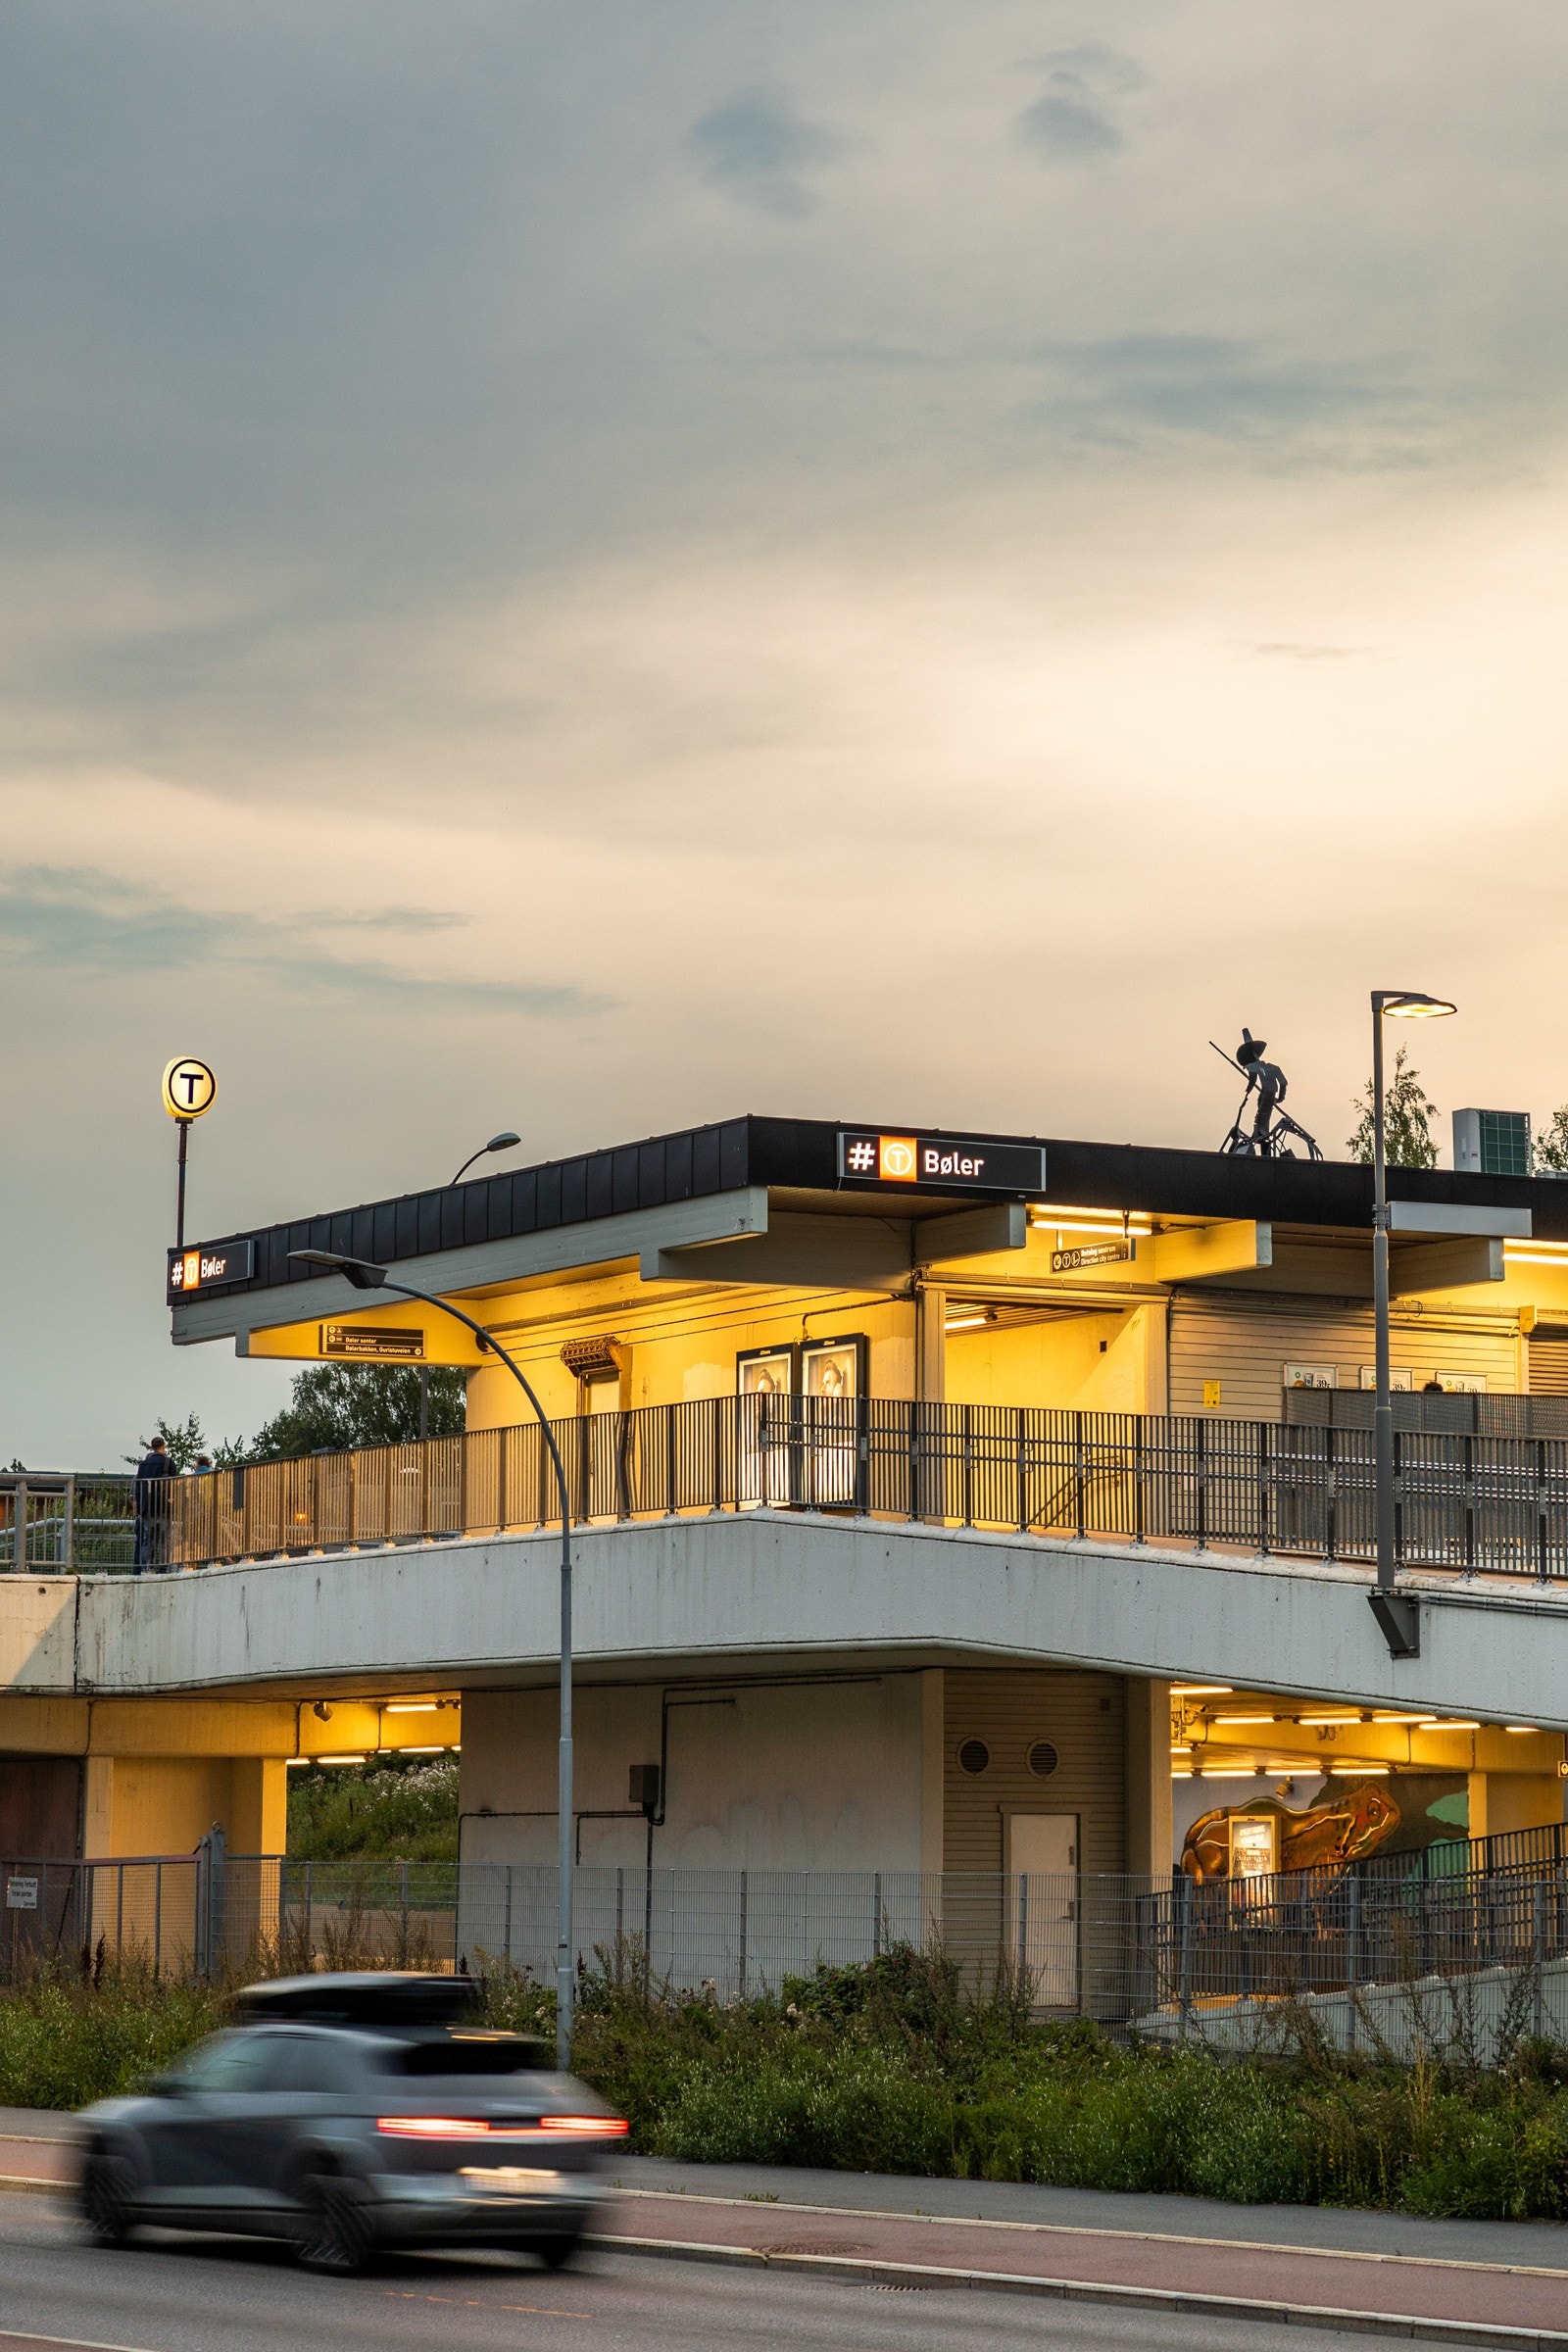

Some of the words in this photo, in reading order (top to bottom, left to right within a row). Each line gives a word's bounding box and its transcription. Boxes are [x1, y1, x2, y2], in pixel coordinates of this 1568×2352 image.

[180, 1073, 204, 1103] T
[924, 1150, 985, 1176] Bøler
[200, 1258, 226, 1278] Bøler
[1081, 1255, 1100, 1266] Direction
[1099, 1254, 1107, 1263] city
